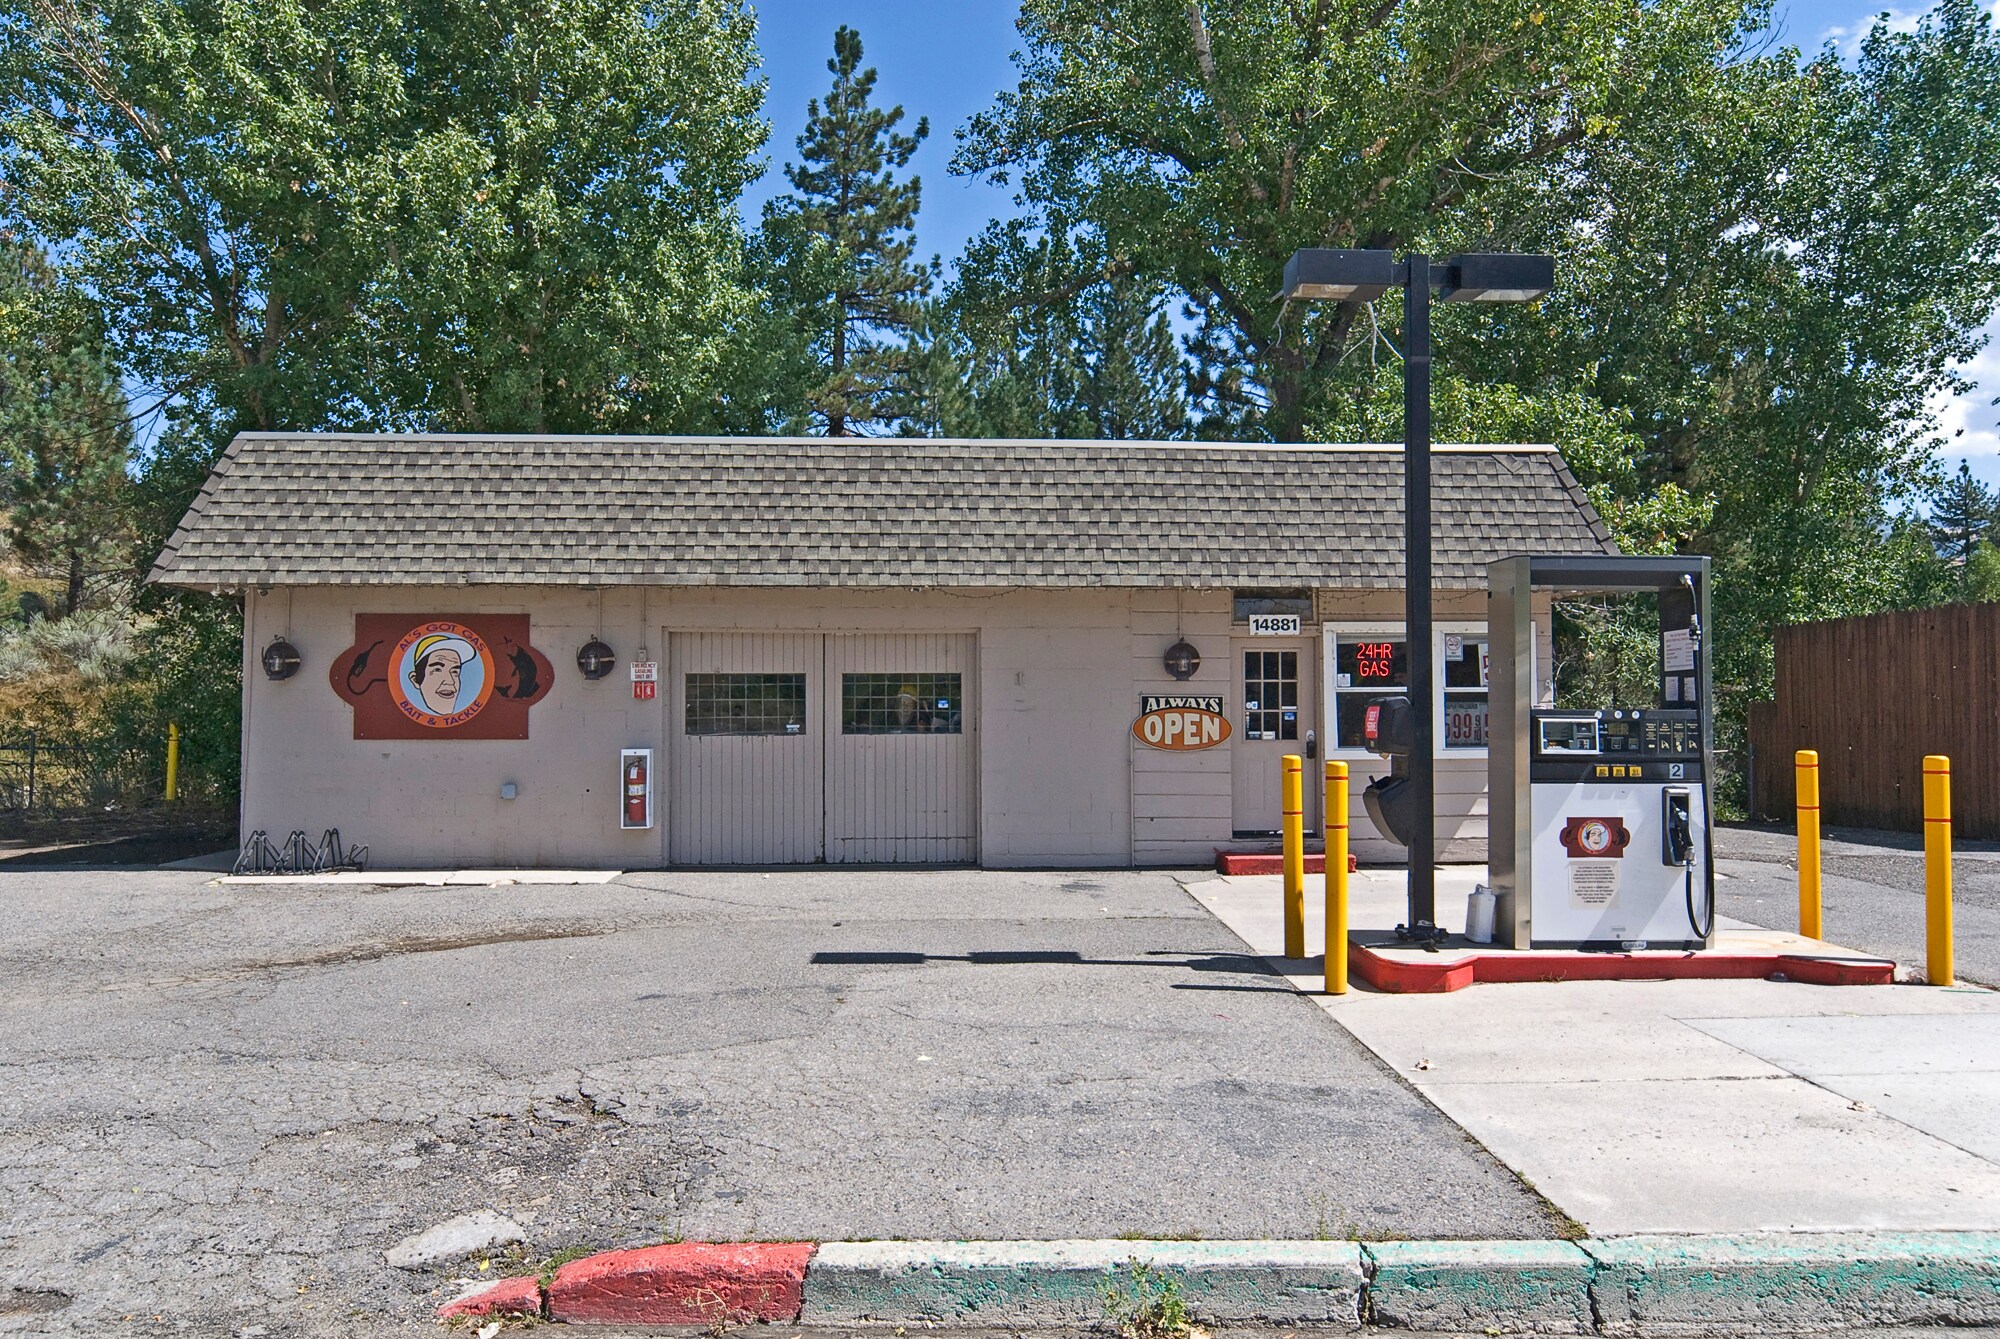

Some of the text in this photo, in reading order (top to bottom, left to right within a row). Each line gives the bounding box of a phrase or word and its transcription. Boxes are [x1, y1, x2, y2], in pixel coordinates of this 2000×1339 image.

[1252, 618, 1297, 631] 14881
[399, 623, 487, 652] AL'S GOT GAS
[1356, 642, 1393, 659] 24HR
[1359, 660, 1389, 677] GAS
[399, 700, 483, 726] BAIT & TACKLE
[1145, 696, 1220, 713] ALWAYS
[1143, 712, 1220, 746] OPEN
[1671, 764, 1681, 777] 2
